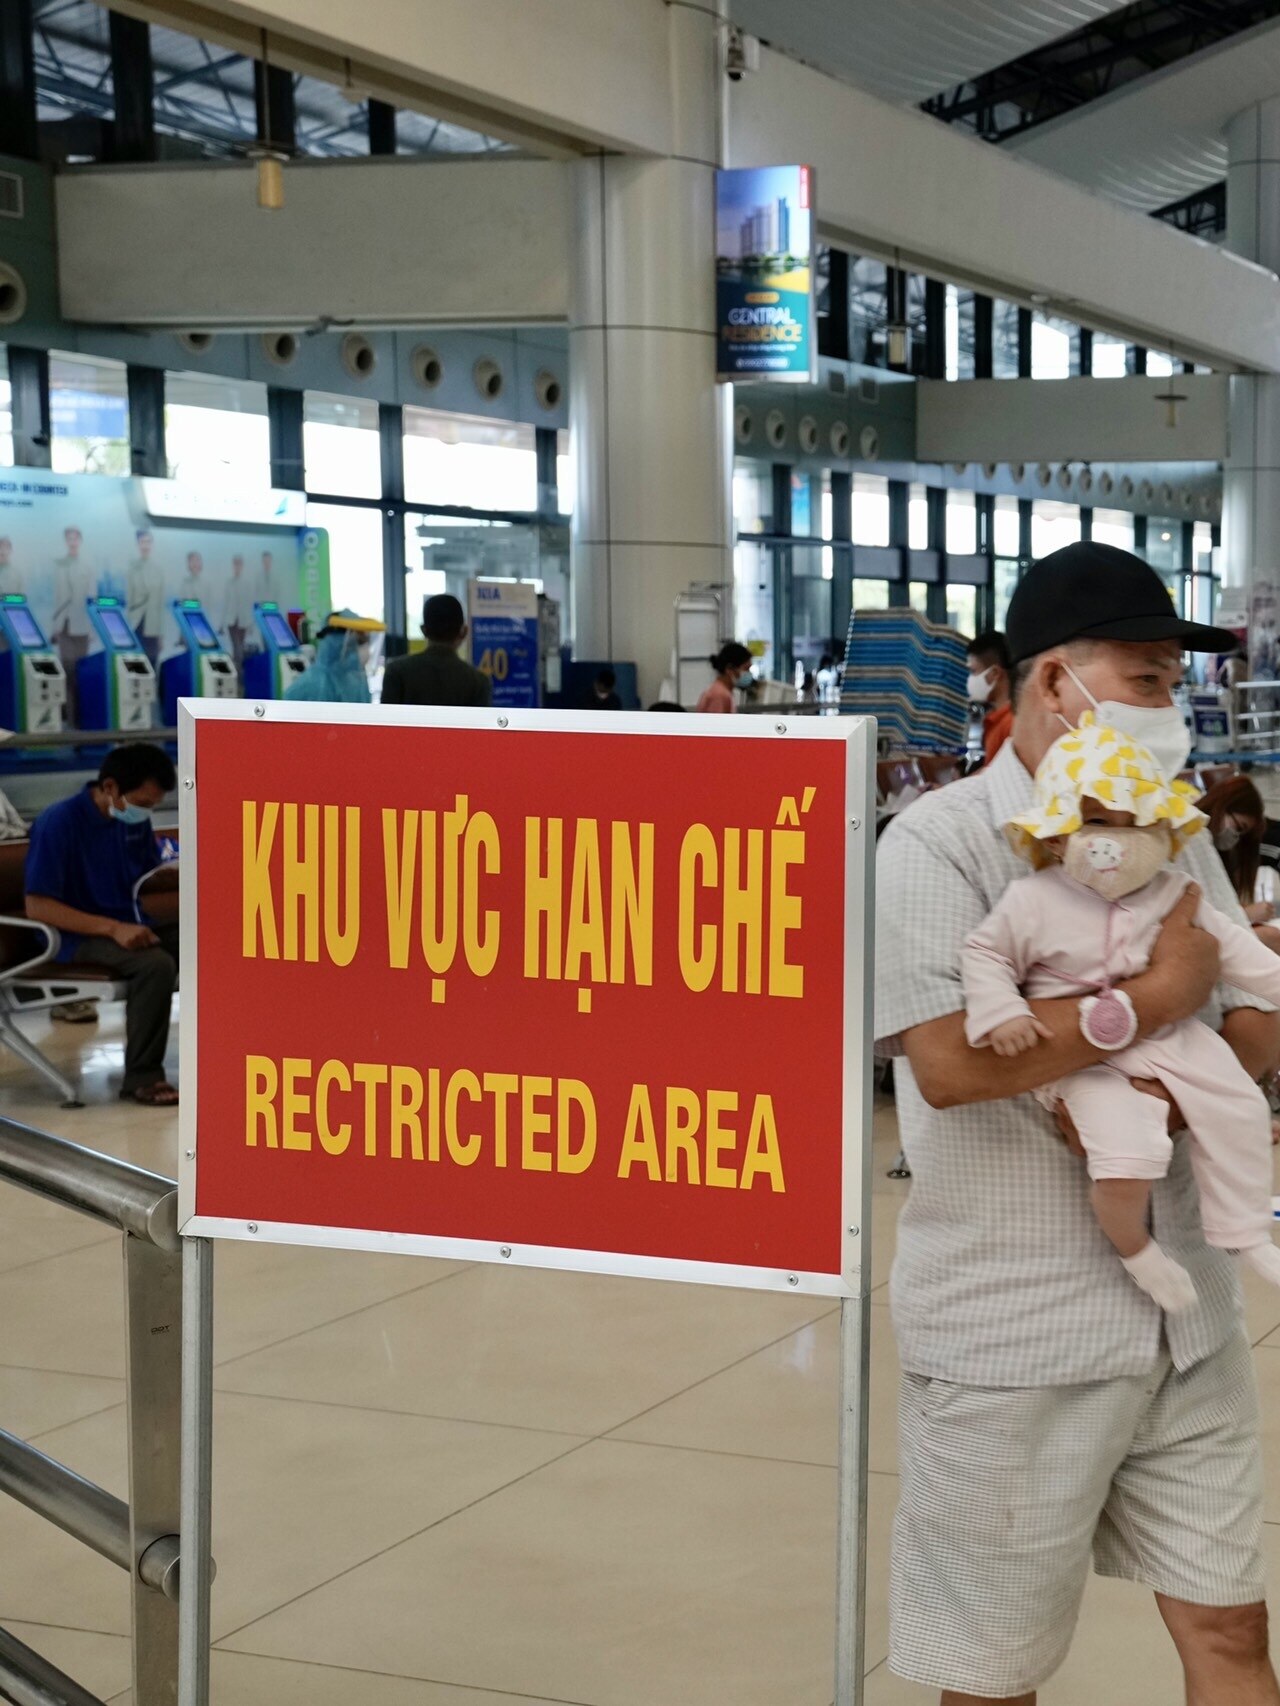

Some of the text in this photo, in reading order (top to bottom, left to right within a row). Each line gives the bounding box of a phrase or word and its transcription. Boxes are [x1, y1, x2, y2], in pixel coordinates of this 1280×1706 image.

[727, 306, 797, 325] CENTRAL
[477, 647, 509, 681] 40
[242, 786, 817, 1014] KHU VỰC HẠN CHẾ
[245, 1053, 787, 1193] RECTRICTED AREA
